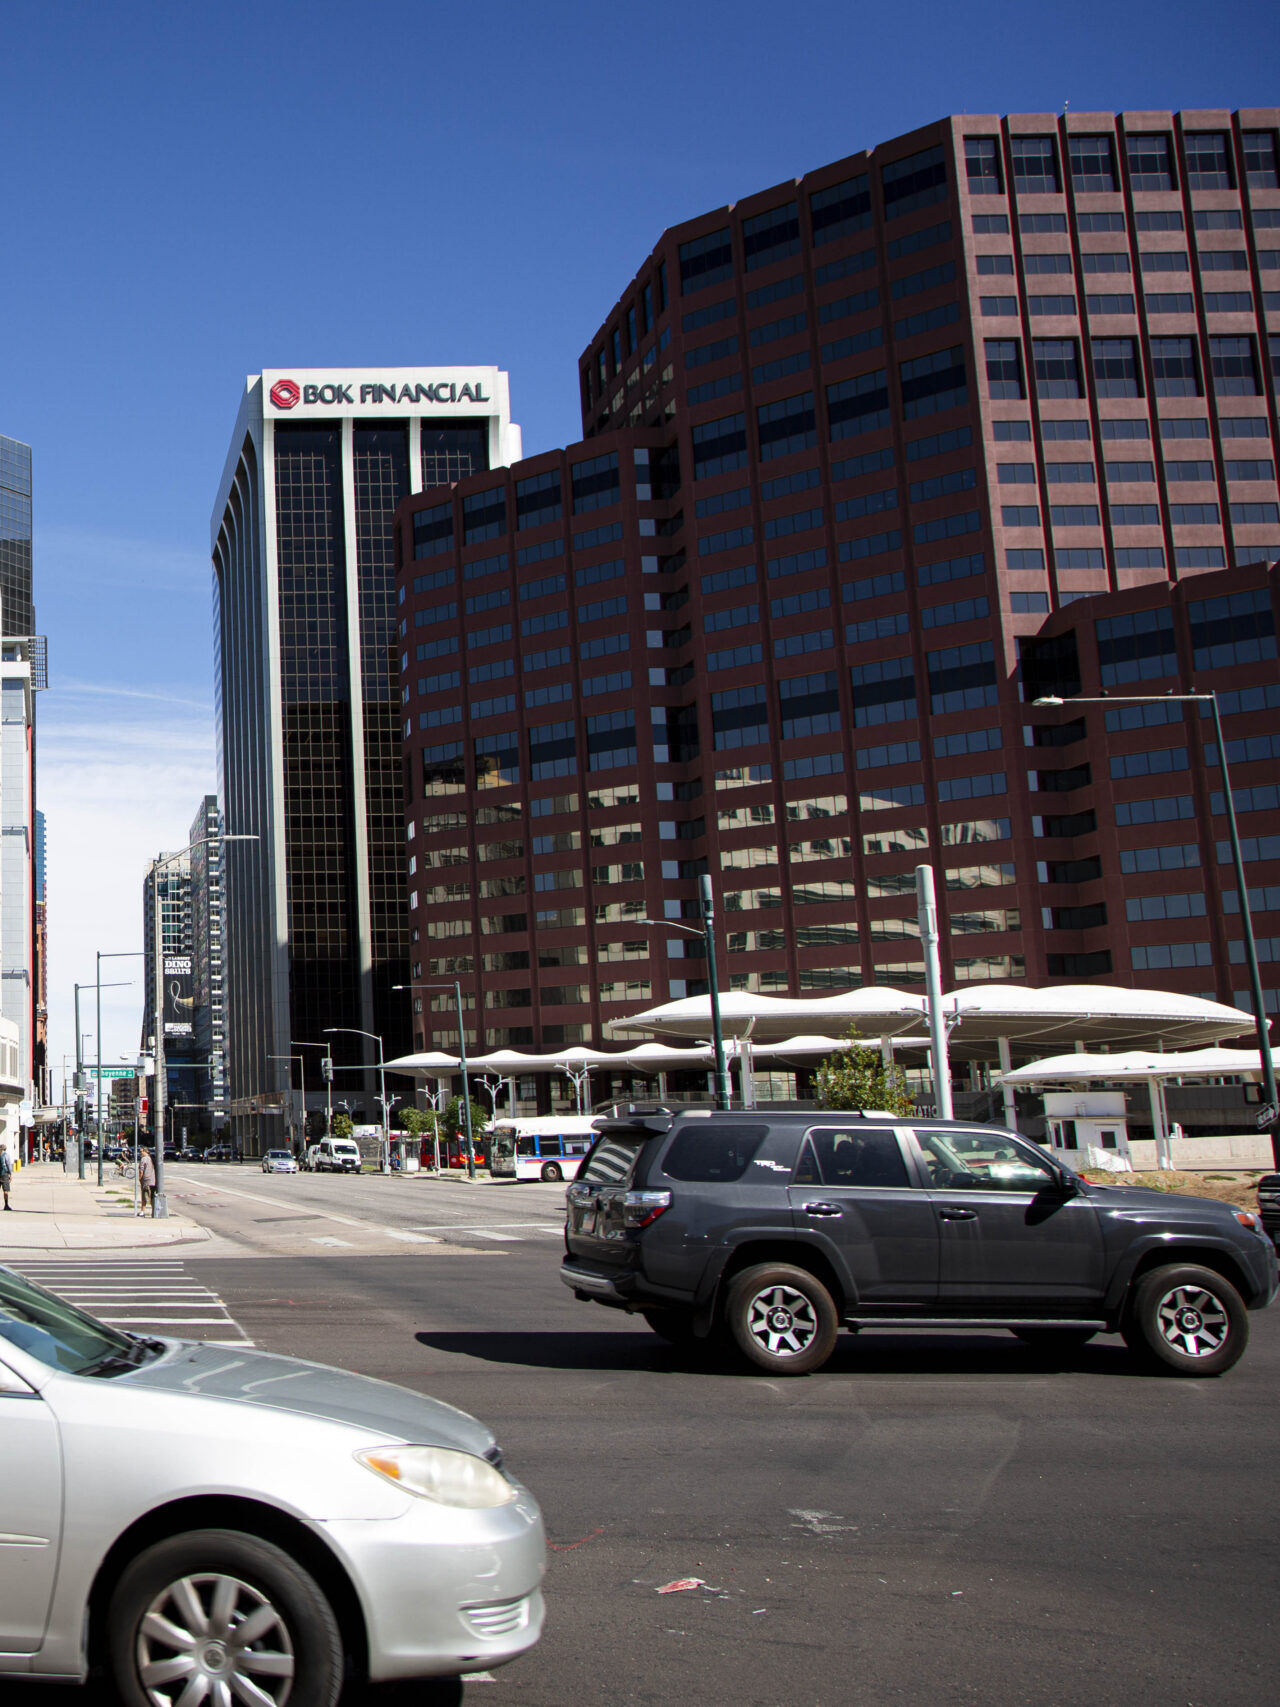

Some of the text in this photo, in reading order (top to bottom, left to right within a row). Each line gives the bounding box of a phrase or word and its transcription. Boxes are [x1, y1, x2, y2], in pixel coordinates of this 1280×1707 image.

[303, 382, 491, 405] BOK FINANCIAL
[164, 960, 192, 968] DINO
[100, 1070, 127, 1078] heyenne
